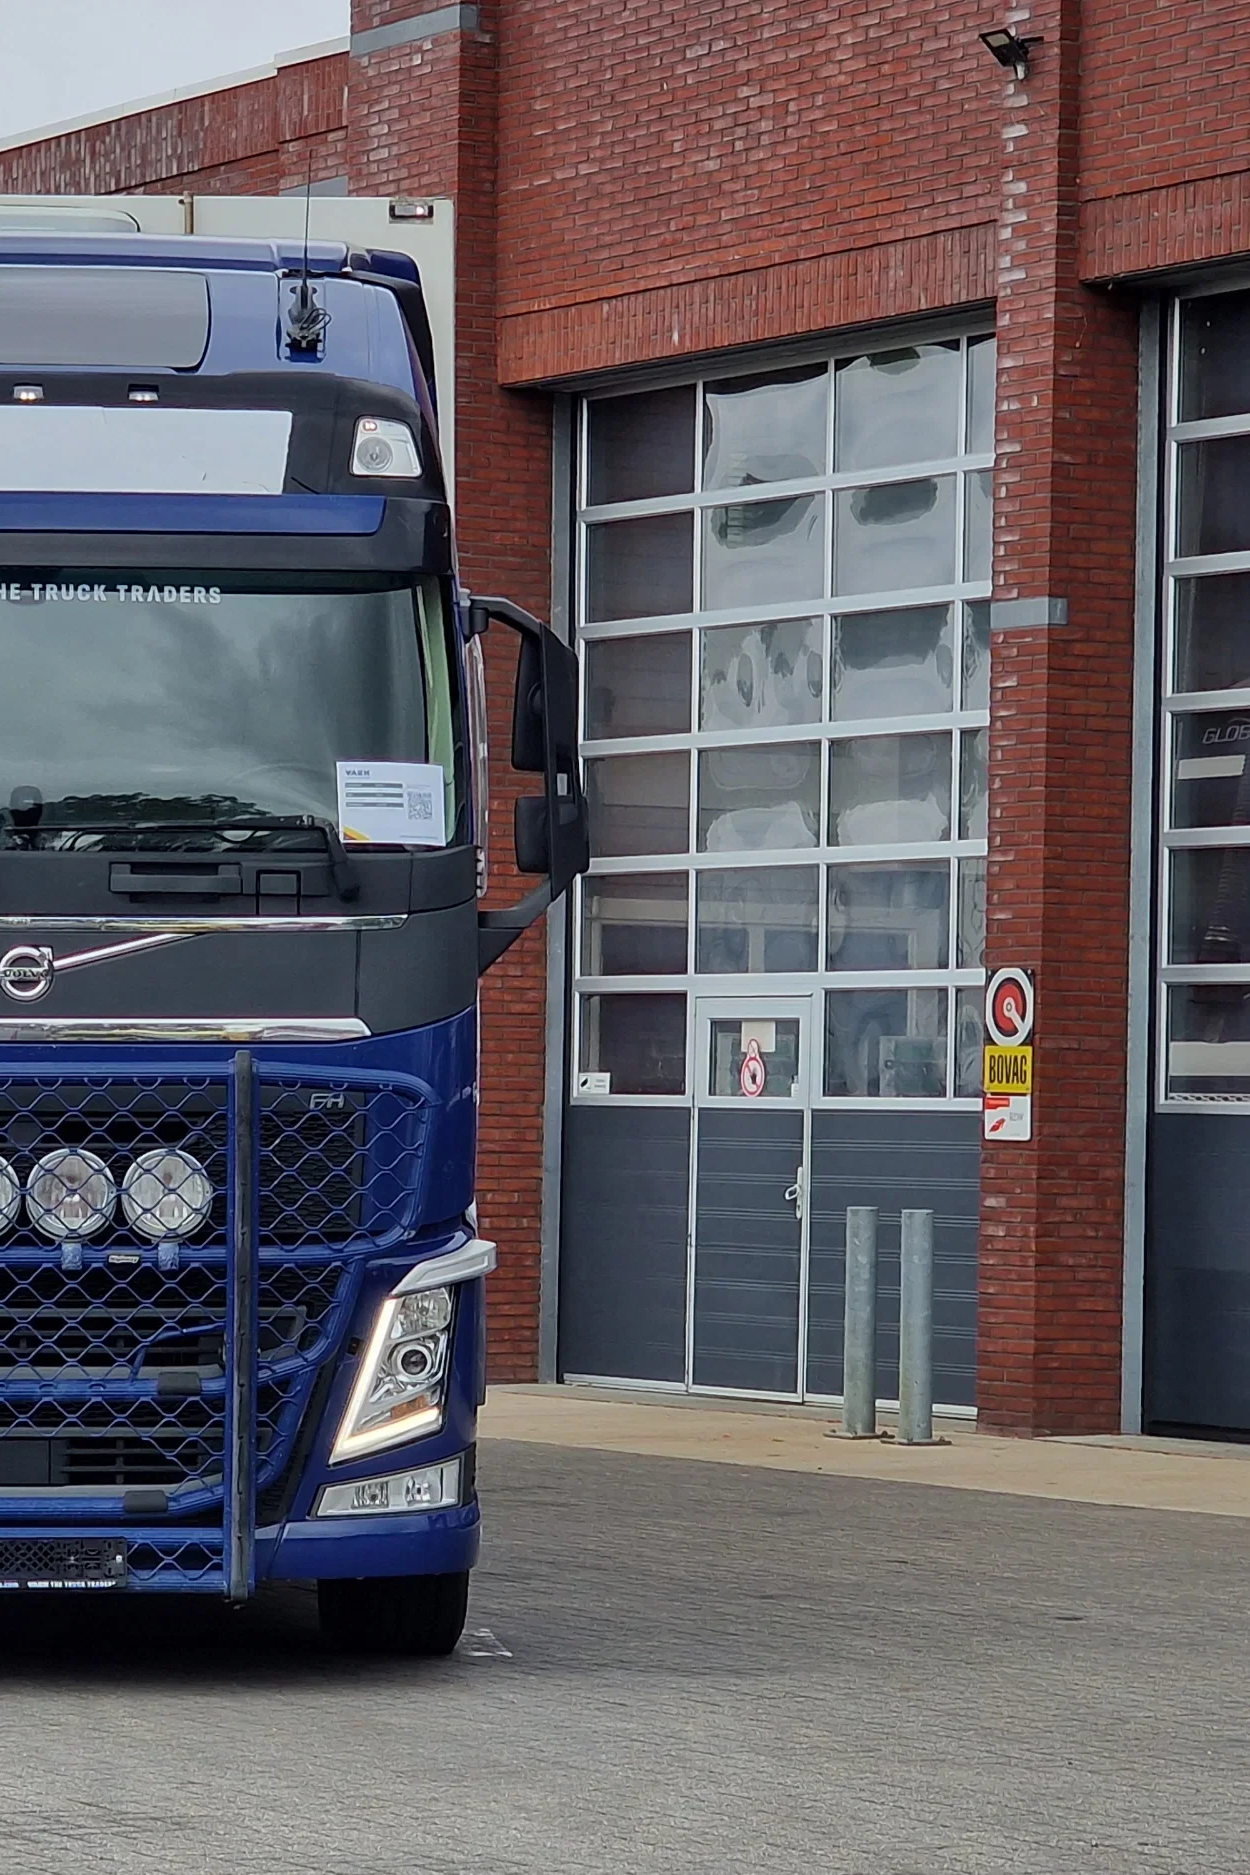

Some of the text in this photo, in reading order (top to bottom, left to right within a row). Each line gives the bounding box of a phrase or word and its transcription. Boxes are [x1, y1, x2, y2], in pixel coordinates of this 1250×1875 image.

[31, 583, 107, 602] TRUCK
[118, 584, 222, 604] TRADERS
[3, 968, 48, 980] VOLVO
[989, 1054, 1027, 1085] BOVAG
